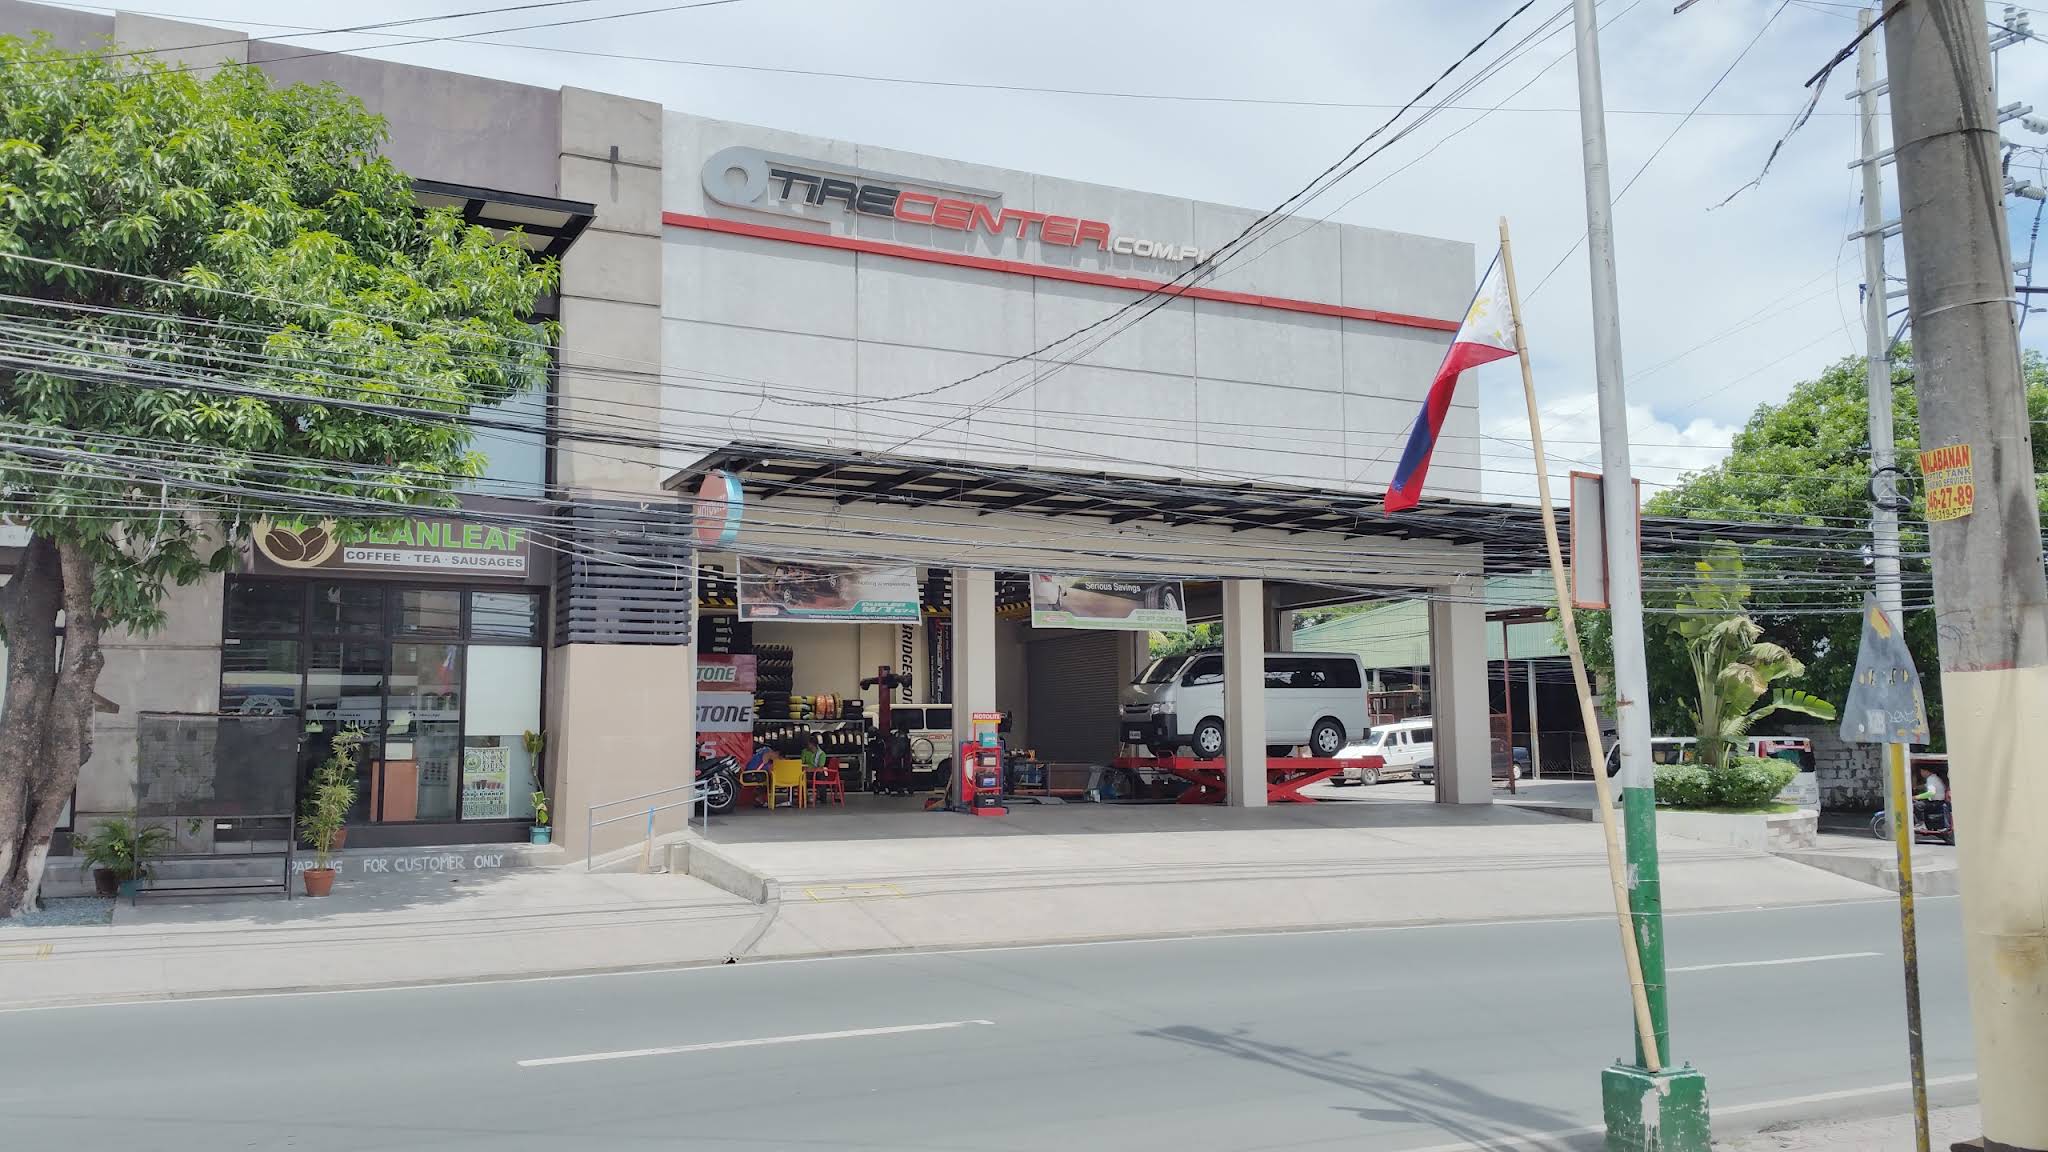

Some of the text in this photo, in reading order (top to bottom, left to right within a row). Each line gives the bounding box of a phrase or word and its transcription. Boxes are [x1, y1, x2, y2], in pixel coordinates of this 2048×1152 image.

[1946, 469, 1971, 478] TANK
[346, 520, 526, 551] EANLEAF
[346, 550, 523, 568] COFFEE TEA SAUSAGES
[1085, 581, 1141, 594] Serious Savings
[363, 858, 390, 873] FOR
[394, 855, 466, 873] CUSTOMER
[474, 854, 503, 869] ONLY
